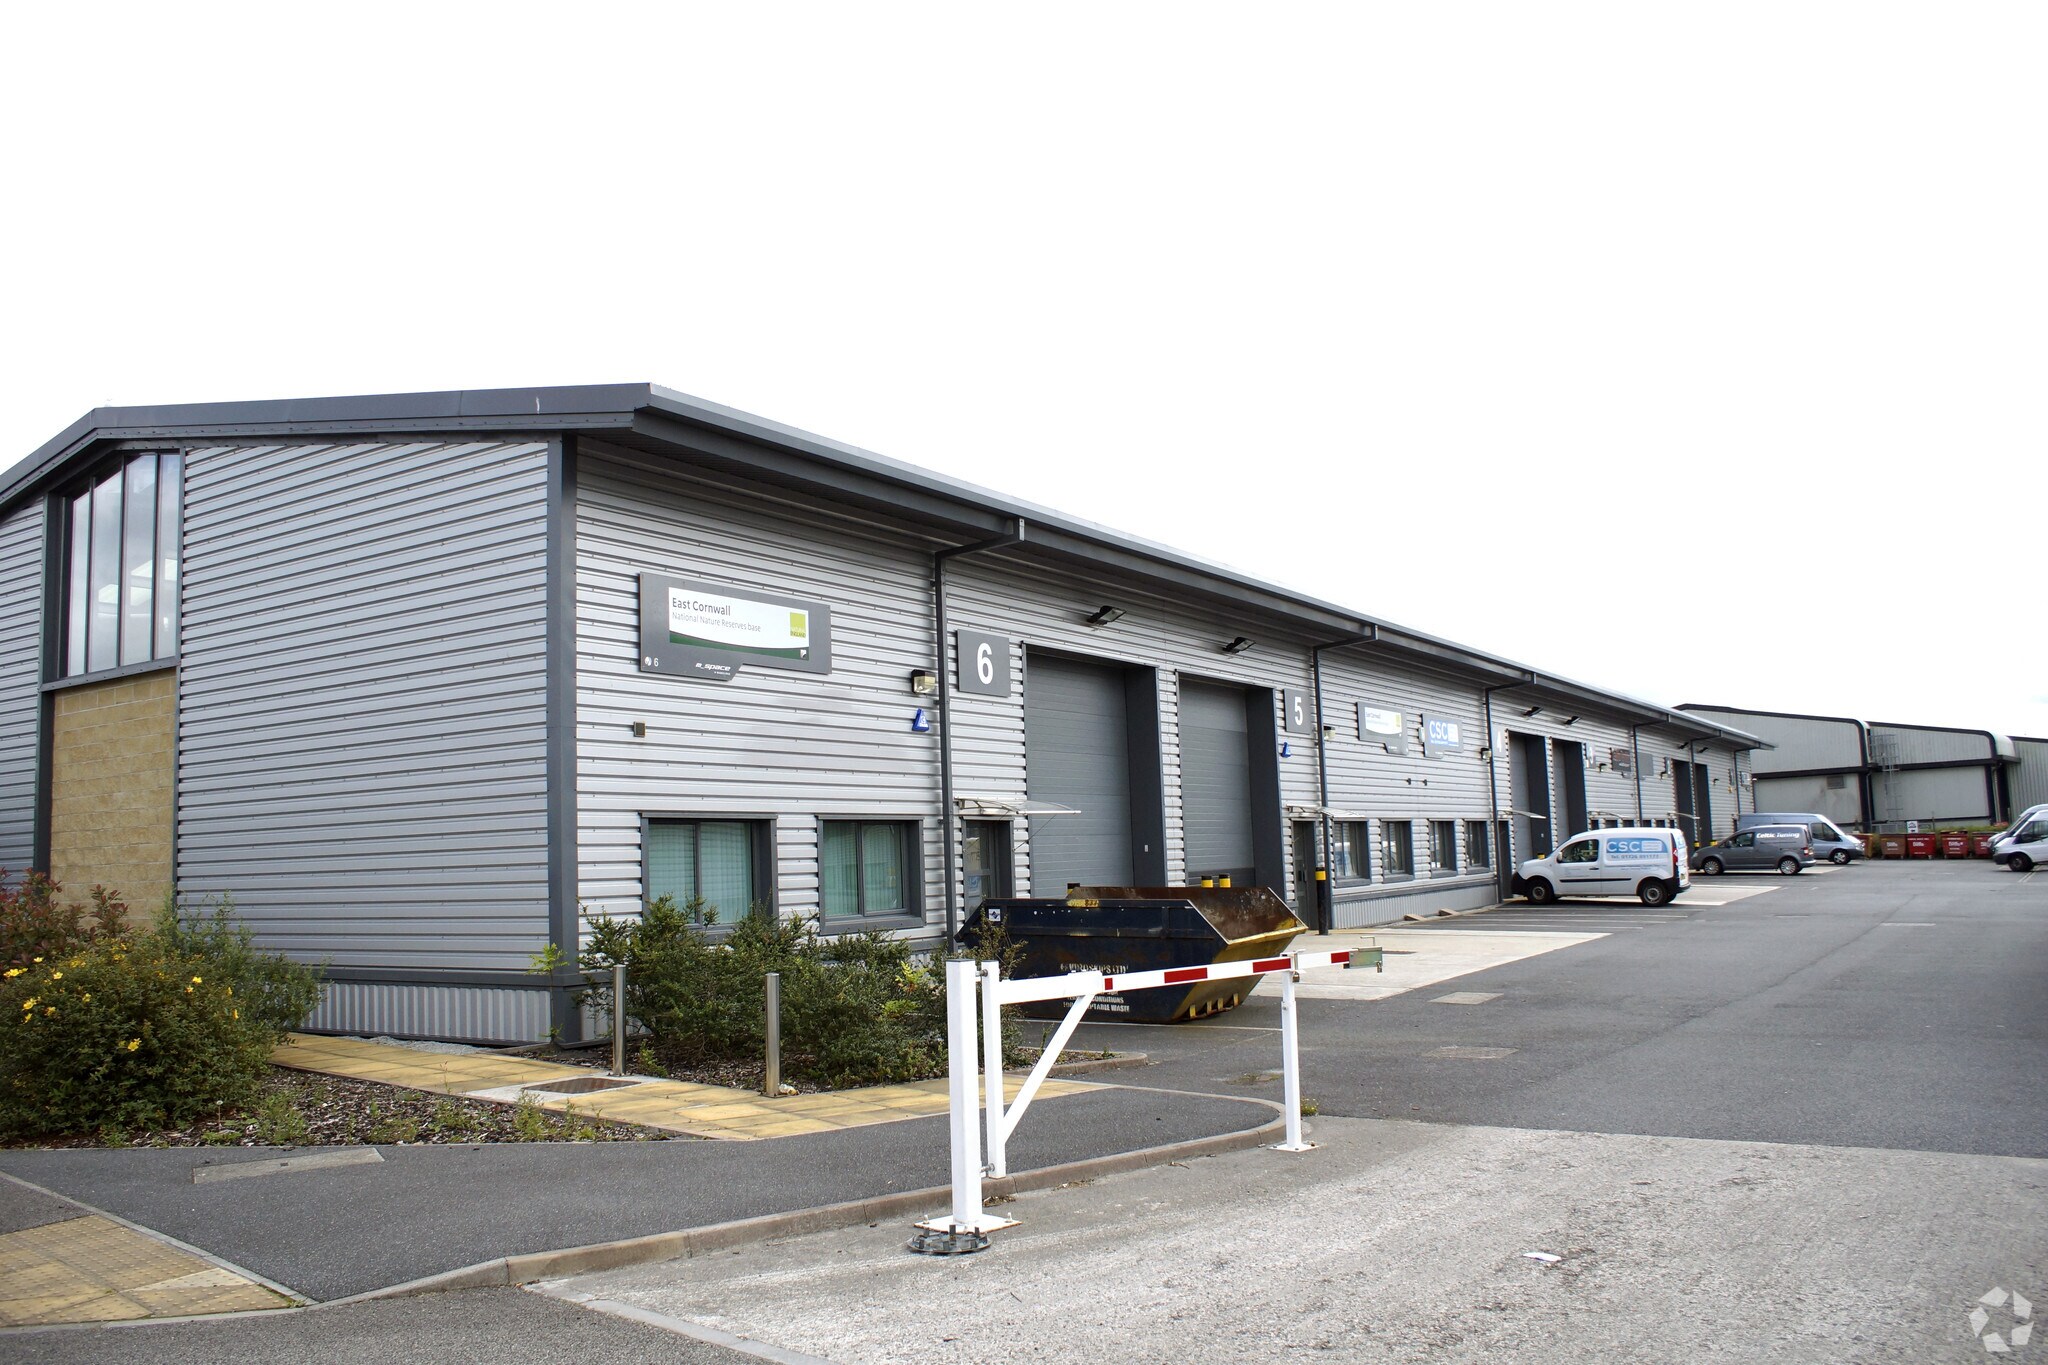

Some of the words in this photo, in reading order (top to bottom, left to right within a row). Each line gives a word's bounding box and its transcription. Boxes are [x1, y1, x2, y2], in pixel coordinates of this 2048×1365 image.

[672, 597, 691, 610] East
[692, 601, 731, 616] Cornwall
[672, 612, 699, 623] National
[700, 615, 721, 627] Nature
[721, 618, 747, 631] Reserves
[747, 622, 762, 633] base
[653, 657, 660, 667] 6
[977, 642, 994, 685] 6
[1294, 696, 1304, 726] 5
[1429, 720, 1448, 740] CSC
[1606, 841, 1640, 852] CSC
